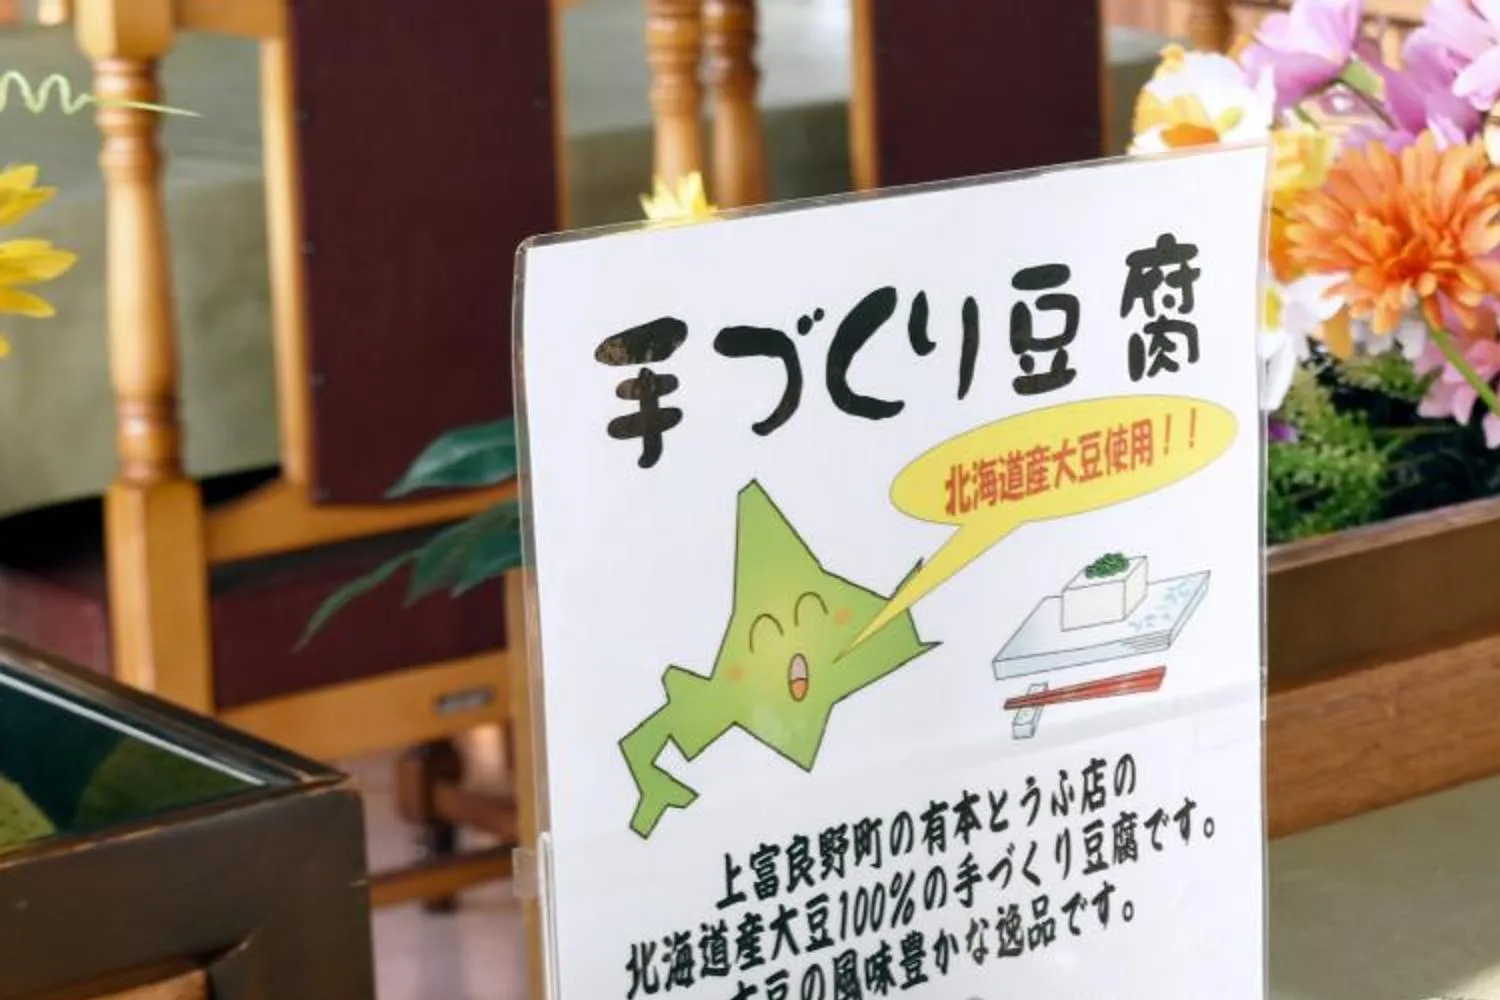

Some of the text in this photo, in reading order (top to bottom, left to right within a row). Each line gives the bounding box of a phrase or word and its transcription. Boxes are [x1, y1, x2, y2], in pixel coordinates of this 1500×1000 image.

[594, 233, 1201, 469] 手づくり豆腐
[715, 753, 1137, 911] 上富良野町の有本とうふ店の
